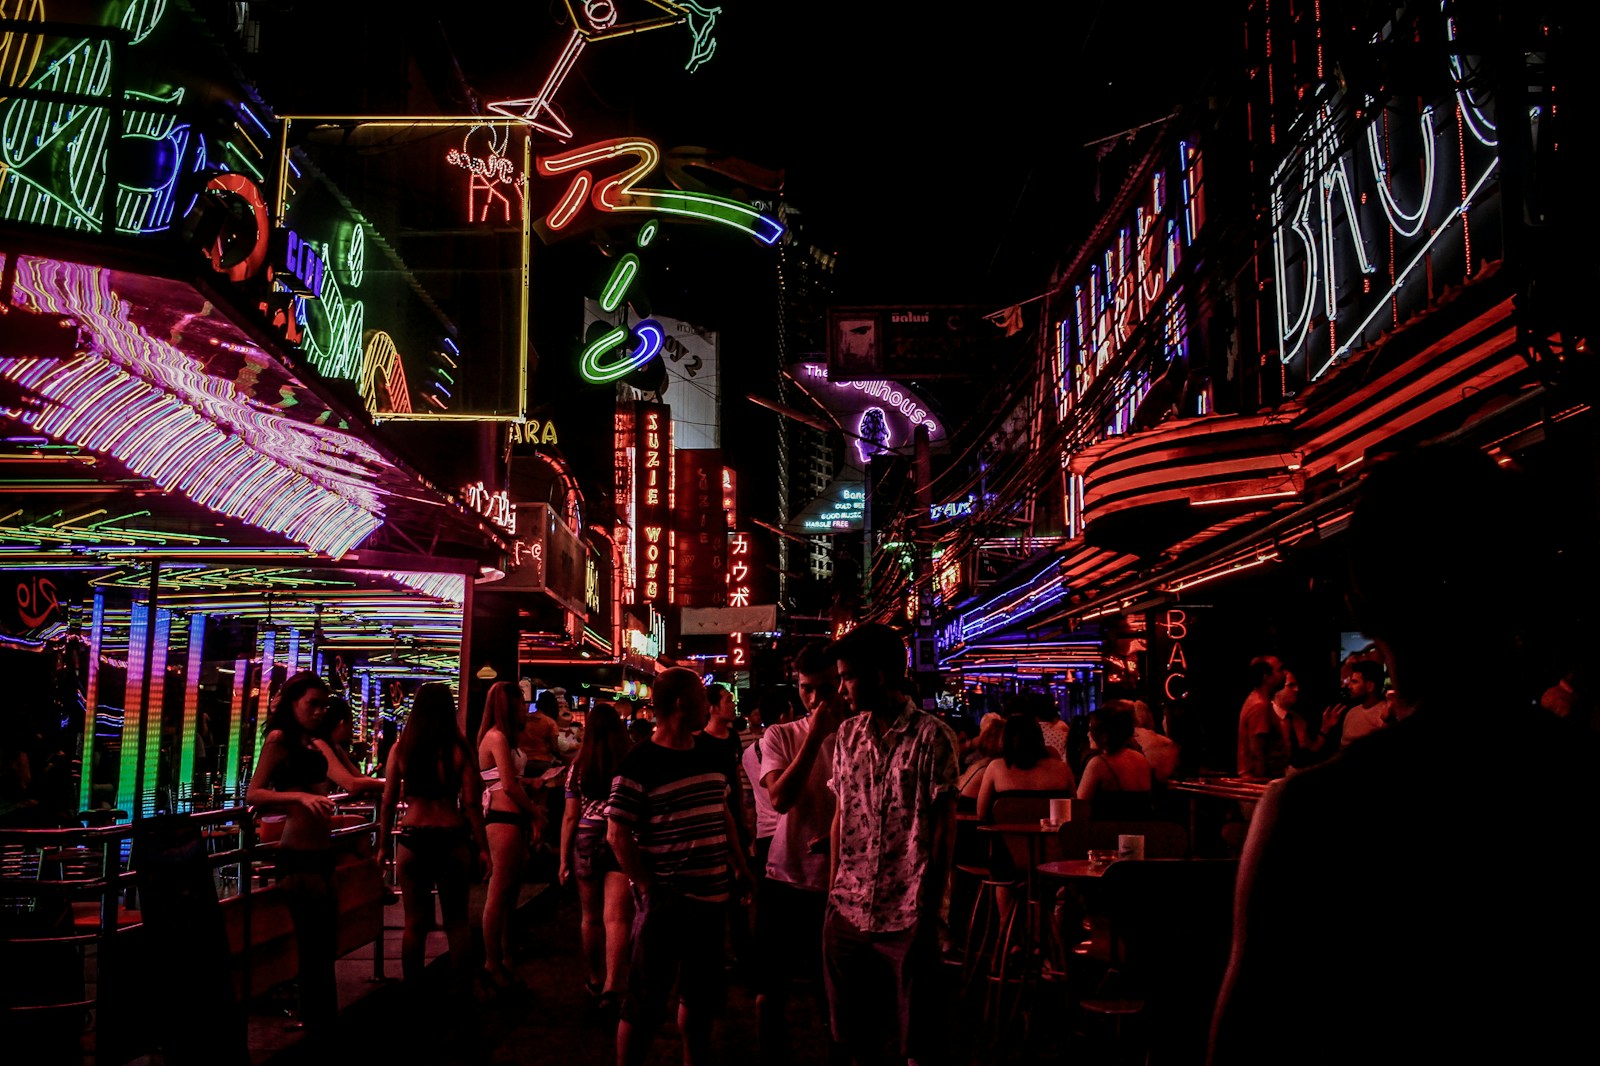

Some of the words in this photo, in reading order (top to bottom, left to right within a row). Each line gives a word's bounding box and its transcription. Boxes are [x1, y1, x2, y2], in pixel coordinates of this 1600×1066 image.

[684, 355, 703, 378] 2
[805, 365, 828, 378] The
[835, 379, 936, 432] ollhouse
[645, 413, 661, 505] SUZIE
[821, 512, 841, 520] GOOD
[832, 520, 849, 528] FREE
[644, 526, 661, 599] WONG
[1164, 609, 1189, 702] BAC
